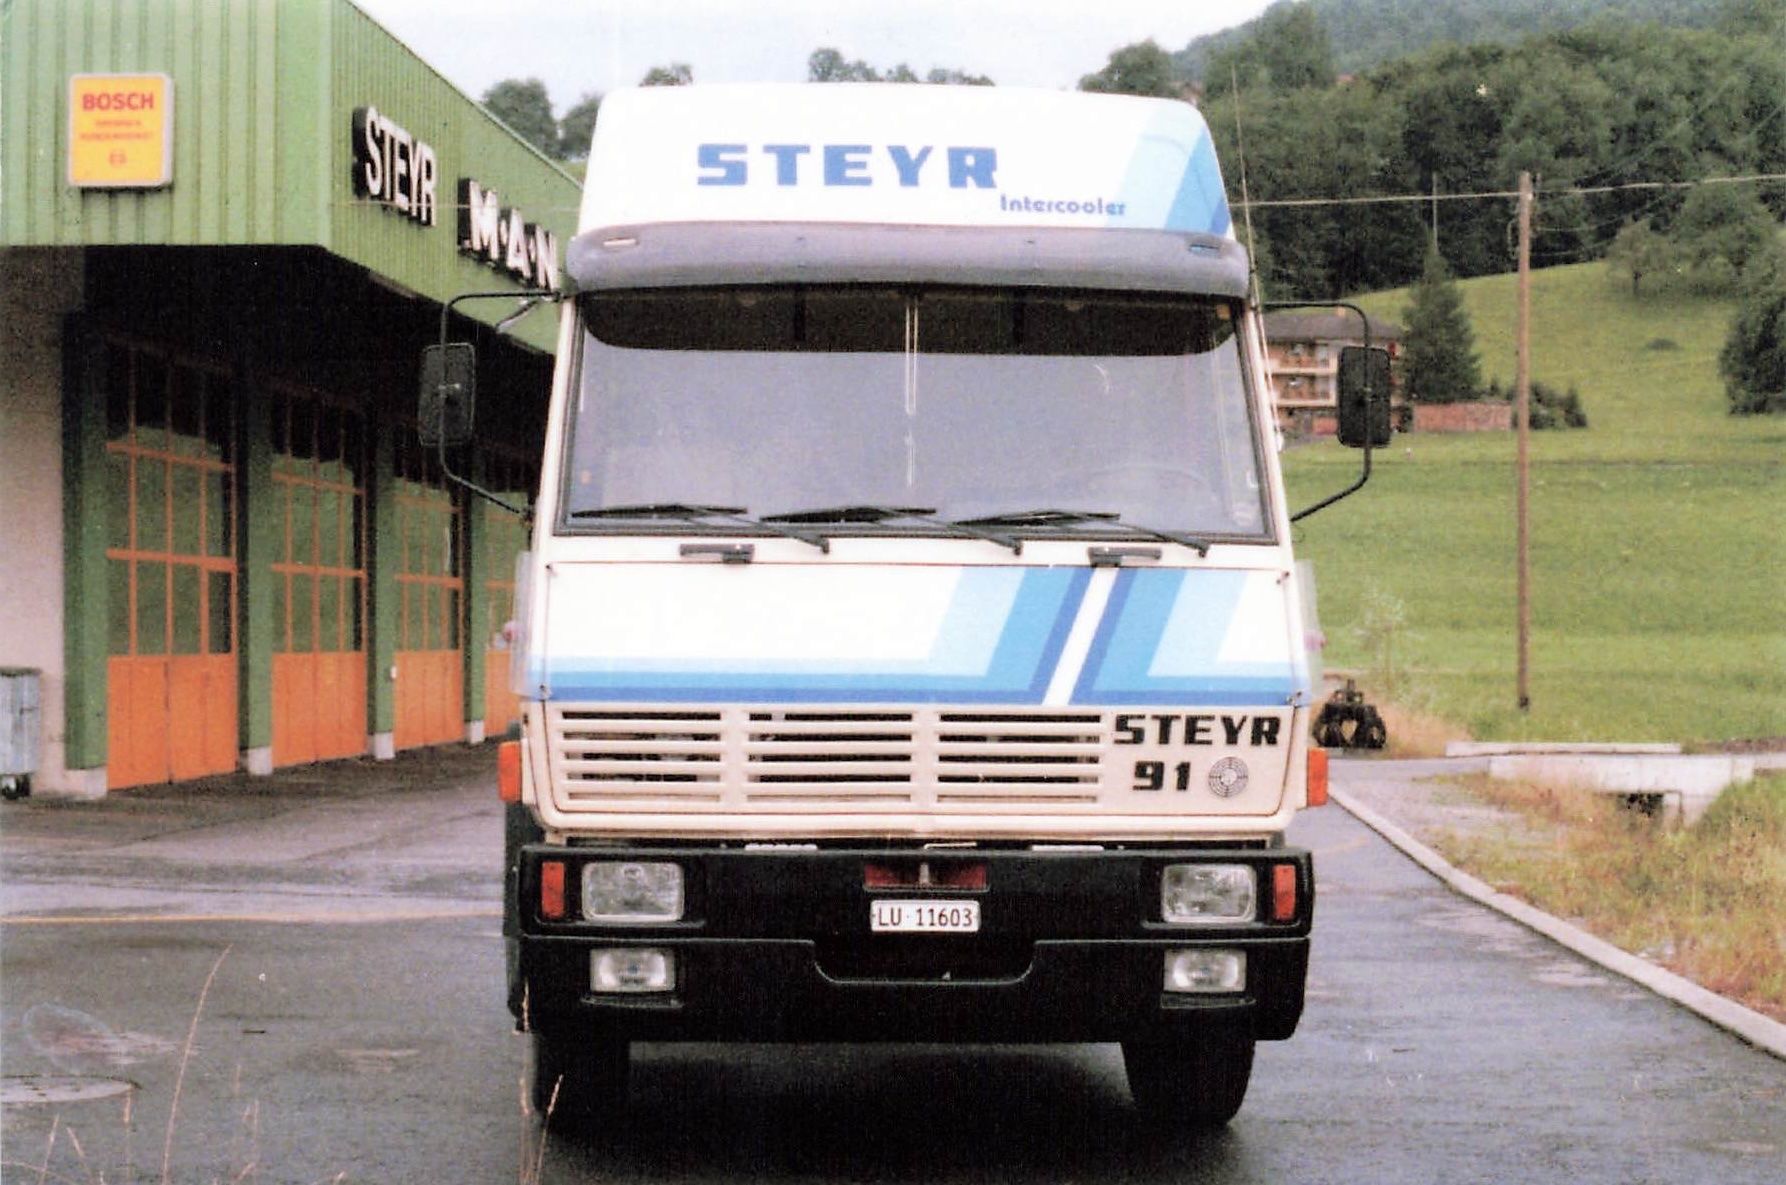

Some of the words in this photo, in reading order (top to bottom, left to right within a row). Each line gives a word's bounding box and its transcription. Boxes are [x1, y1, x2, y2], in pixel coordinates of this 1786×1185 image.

[82, 92, 154, 112] BOSCH
[364, 106, 437, 227] STEYR
[697, 143, 998, 189] STEYR
[1000, 194, 1127, 216] Intercooler
[1113, 713, 1281, 747] STEYR
[1132, 760, 1191, 791] 91
[915, 907, 973, 927] 11603
